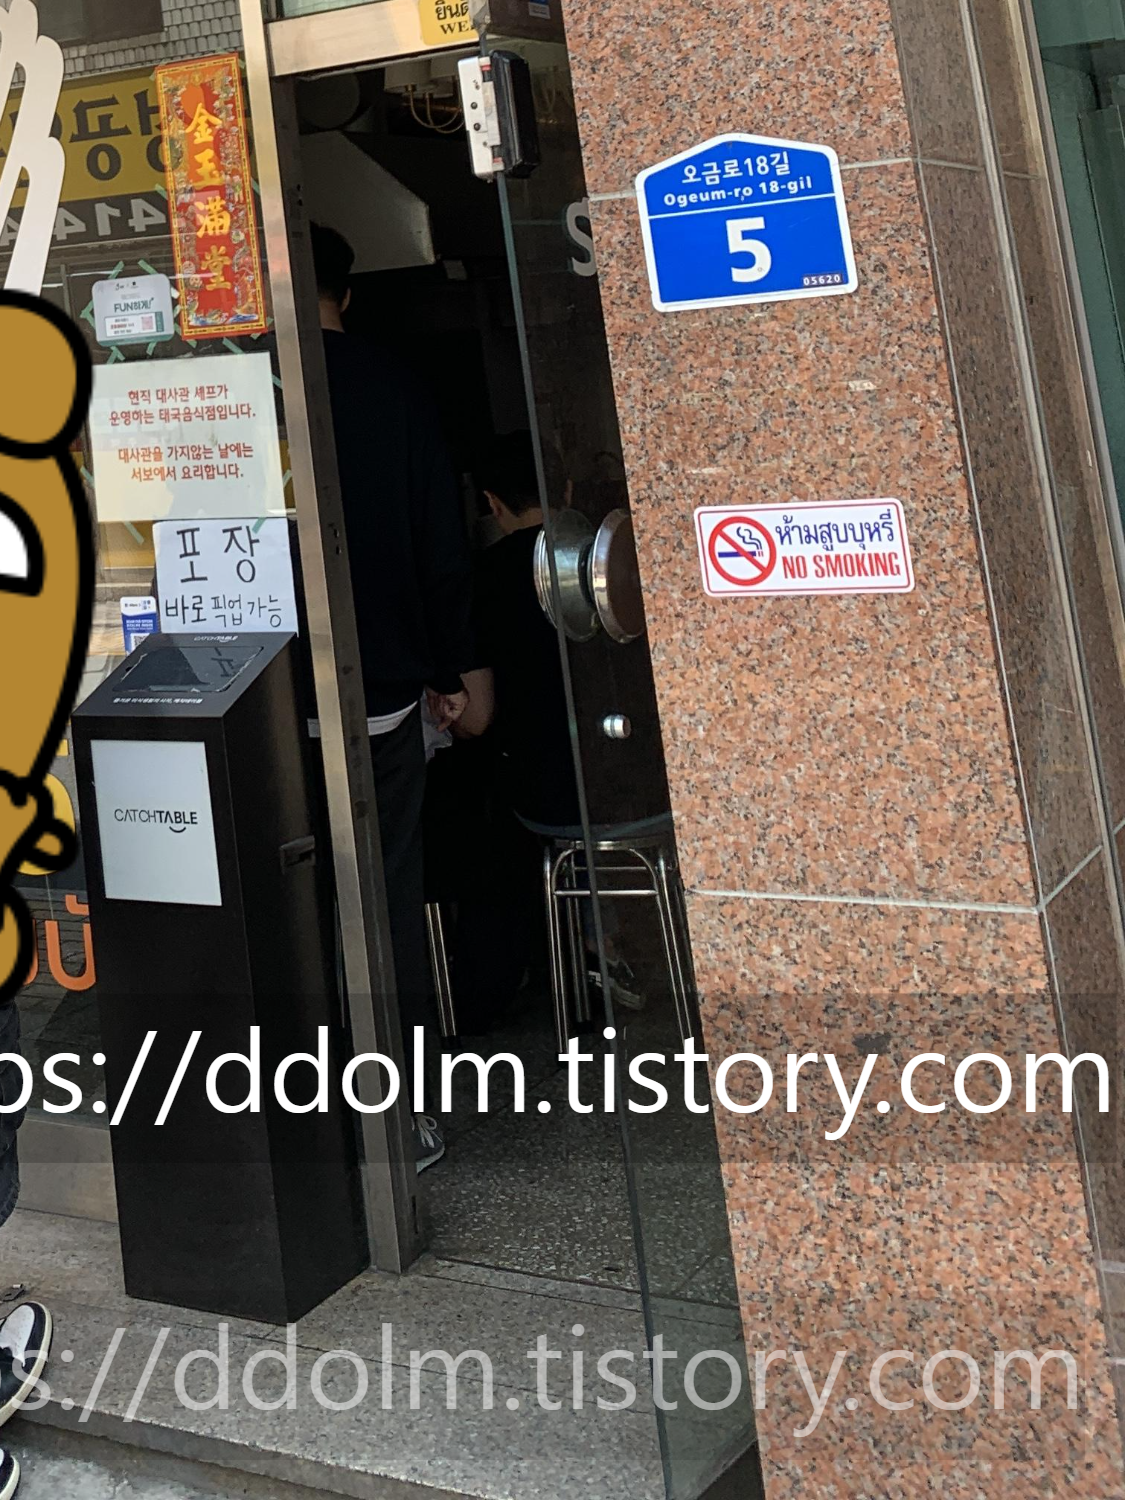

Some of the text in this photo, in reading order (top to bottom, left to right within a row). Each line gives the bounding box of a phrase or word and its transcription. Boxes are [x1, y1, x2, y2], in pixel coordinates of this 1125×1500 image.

[440, 19, 475, 35] WE
[682, 151, 792, 185] 오금로18길
[663, 175, 813, 207] Ogeum-ro 18-gil
[724, 216, 773, 283] 5
[802, 274, 842, 286] 05620
[128, 389, 151, 405] 현직
[155, 387, 190, 403] 대사관
[109, 403, 256, 426] 운영하는 태국음식점입니다.
[118, 442, 254, 463] 대사관을 가지않는 날에는
[131, 463, 244, 483] 서보에서 요리합니다.
[774, 507, 897, 553] ห้ามสูบบุหรี่
[782, 551, 902, 580] NO SMOKING
[165, 593, 282, 628] 바로 픽업 가능
[114, 808, 198, 826] CATCHTABLE
